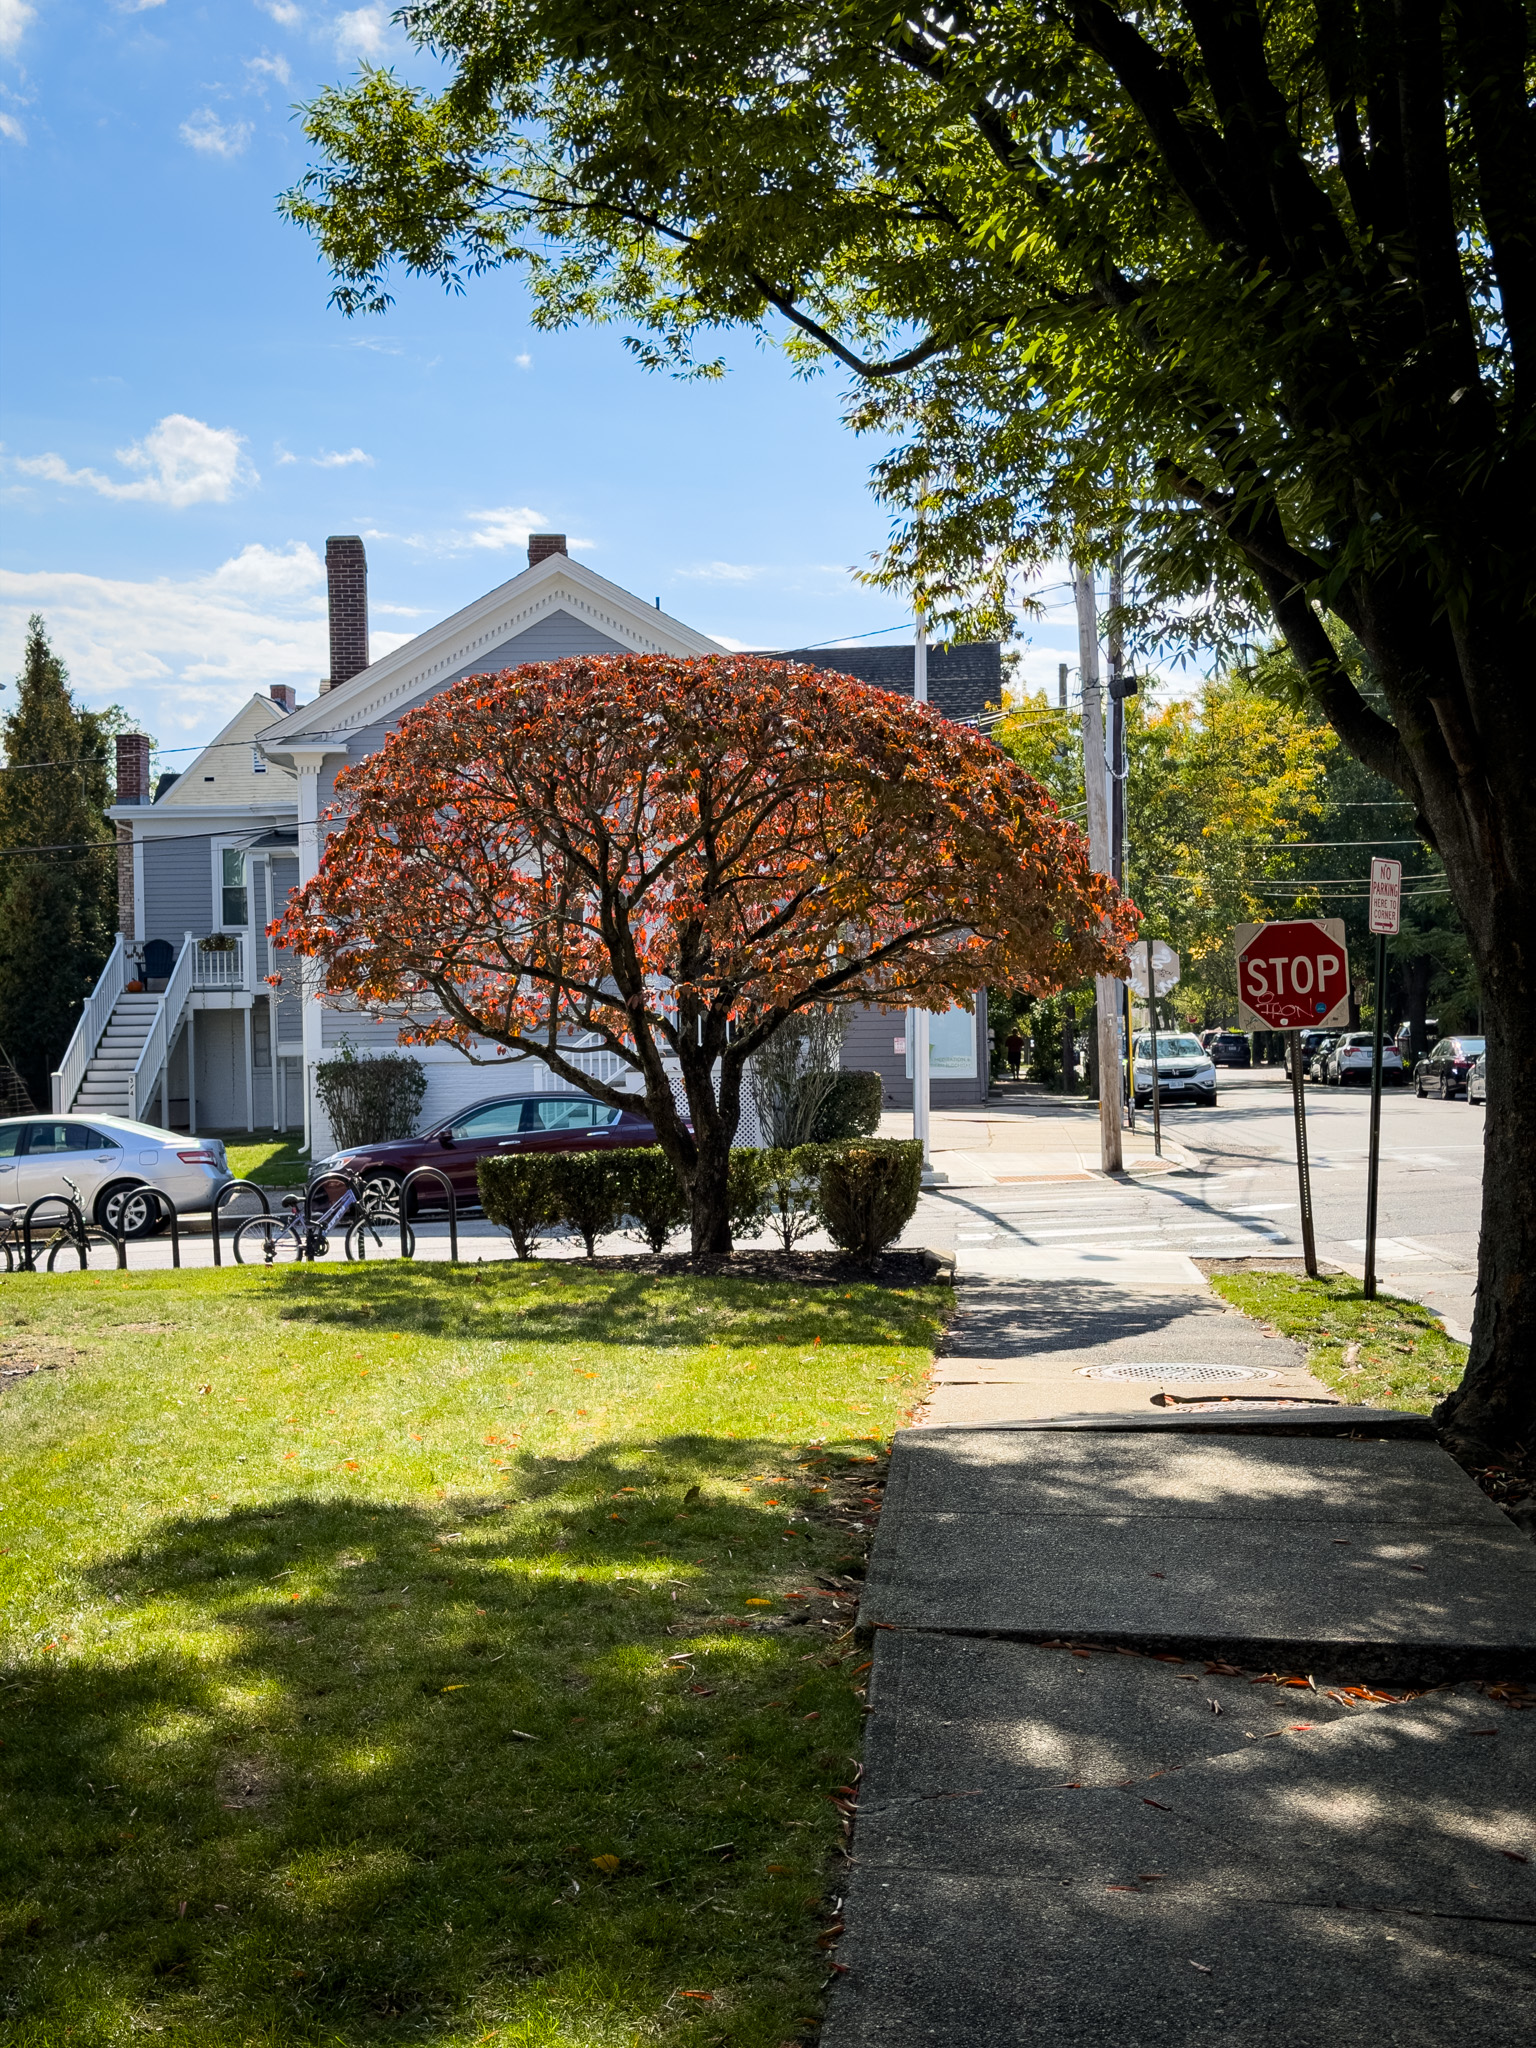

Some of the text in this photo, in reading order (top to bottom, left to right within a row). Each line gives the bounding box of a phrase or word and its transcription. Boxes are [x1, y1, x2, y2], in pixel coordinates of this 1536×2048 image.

[1380, 866, 1391, 880] NO
[1373, 881, 1398, 897] PARKING
[1374, 898, 1397, 909] HERE TO
[1374, 909, 1396, 920] CORNER
[1246, 954, 1340, 997] STOP
